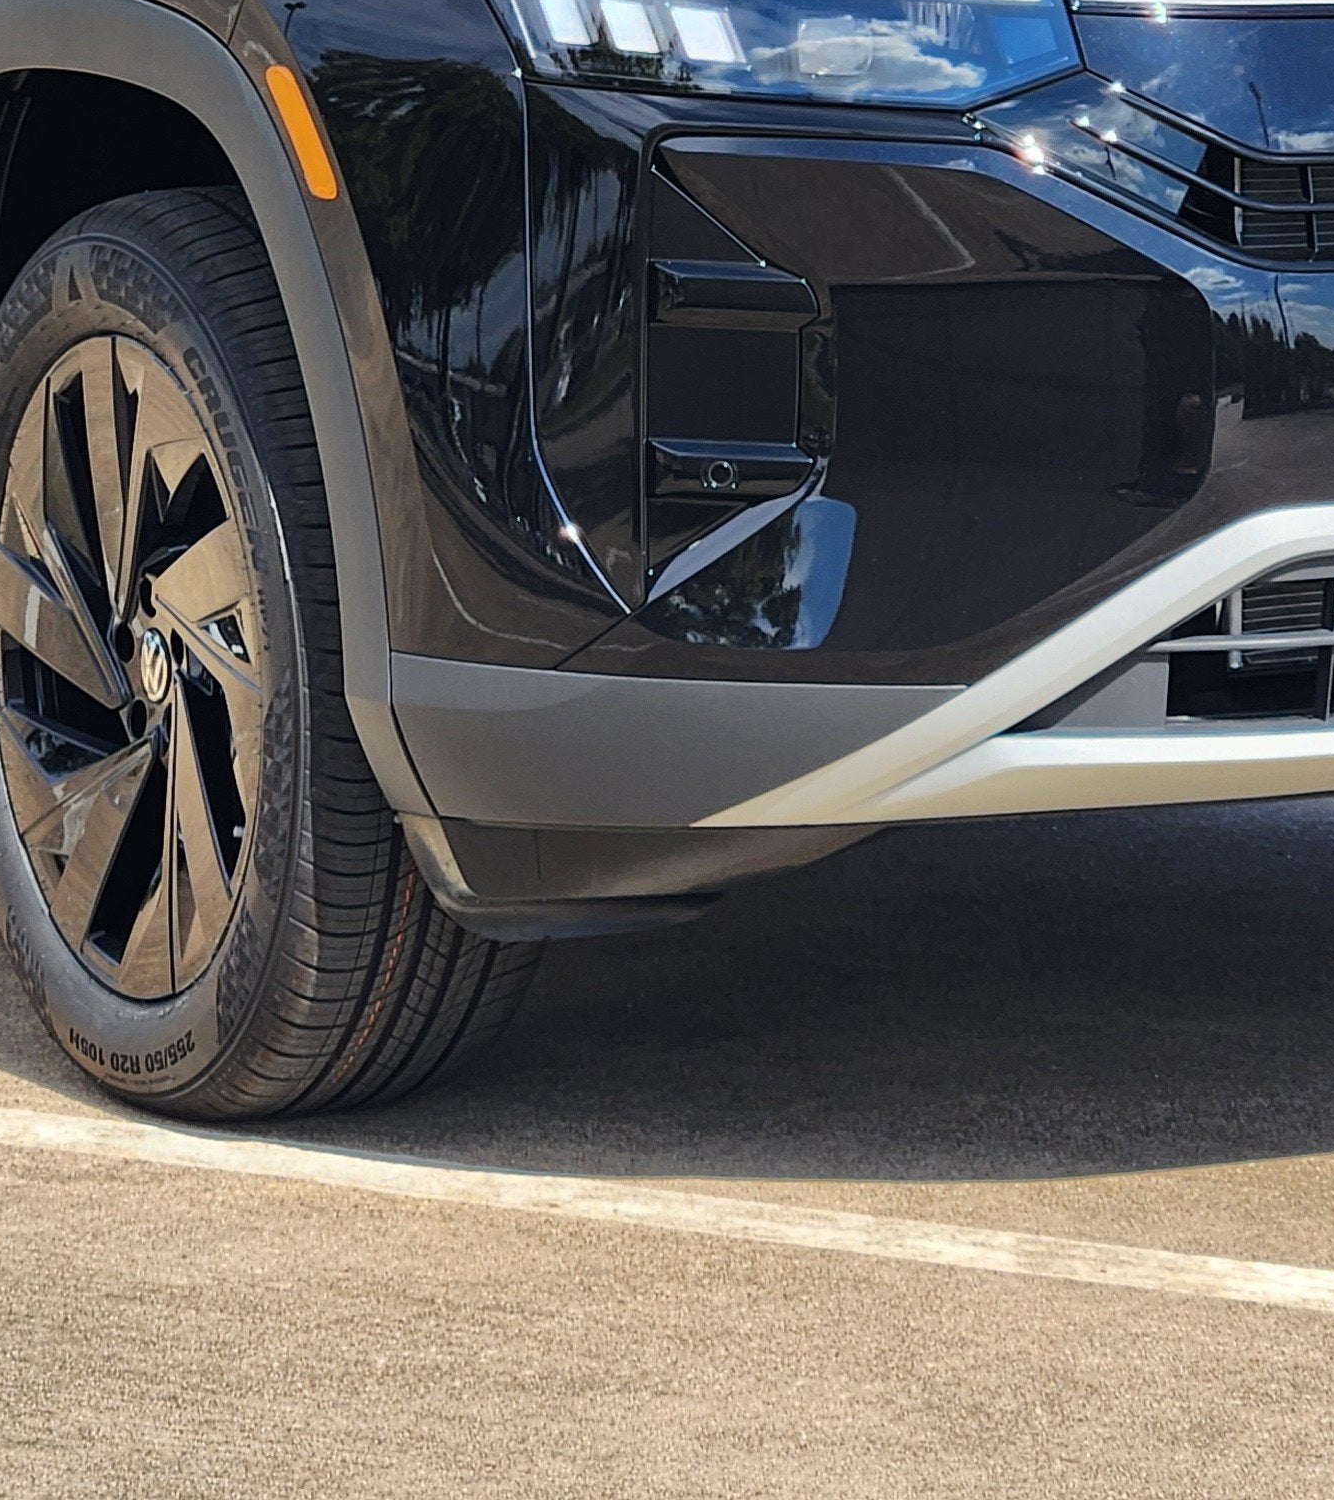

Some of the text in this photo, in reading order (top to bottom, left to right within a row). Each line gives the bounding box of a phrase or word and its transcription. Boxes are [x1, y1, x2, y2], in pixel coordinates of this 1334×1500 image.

[182, 346, 270, 571] CRUGEN
[69, 1027, 196, 1075] 255/50 R20 105H
